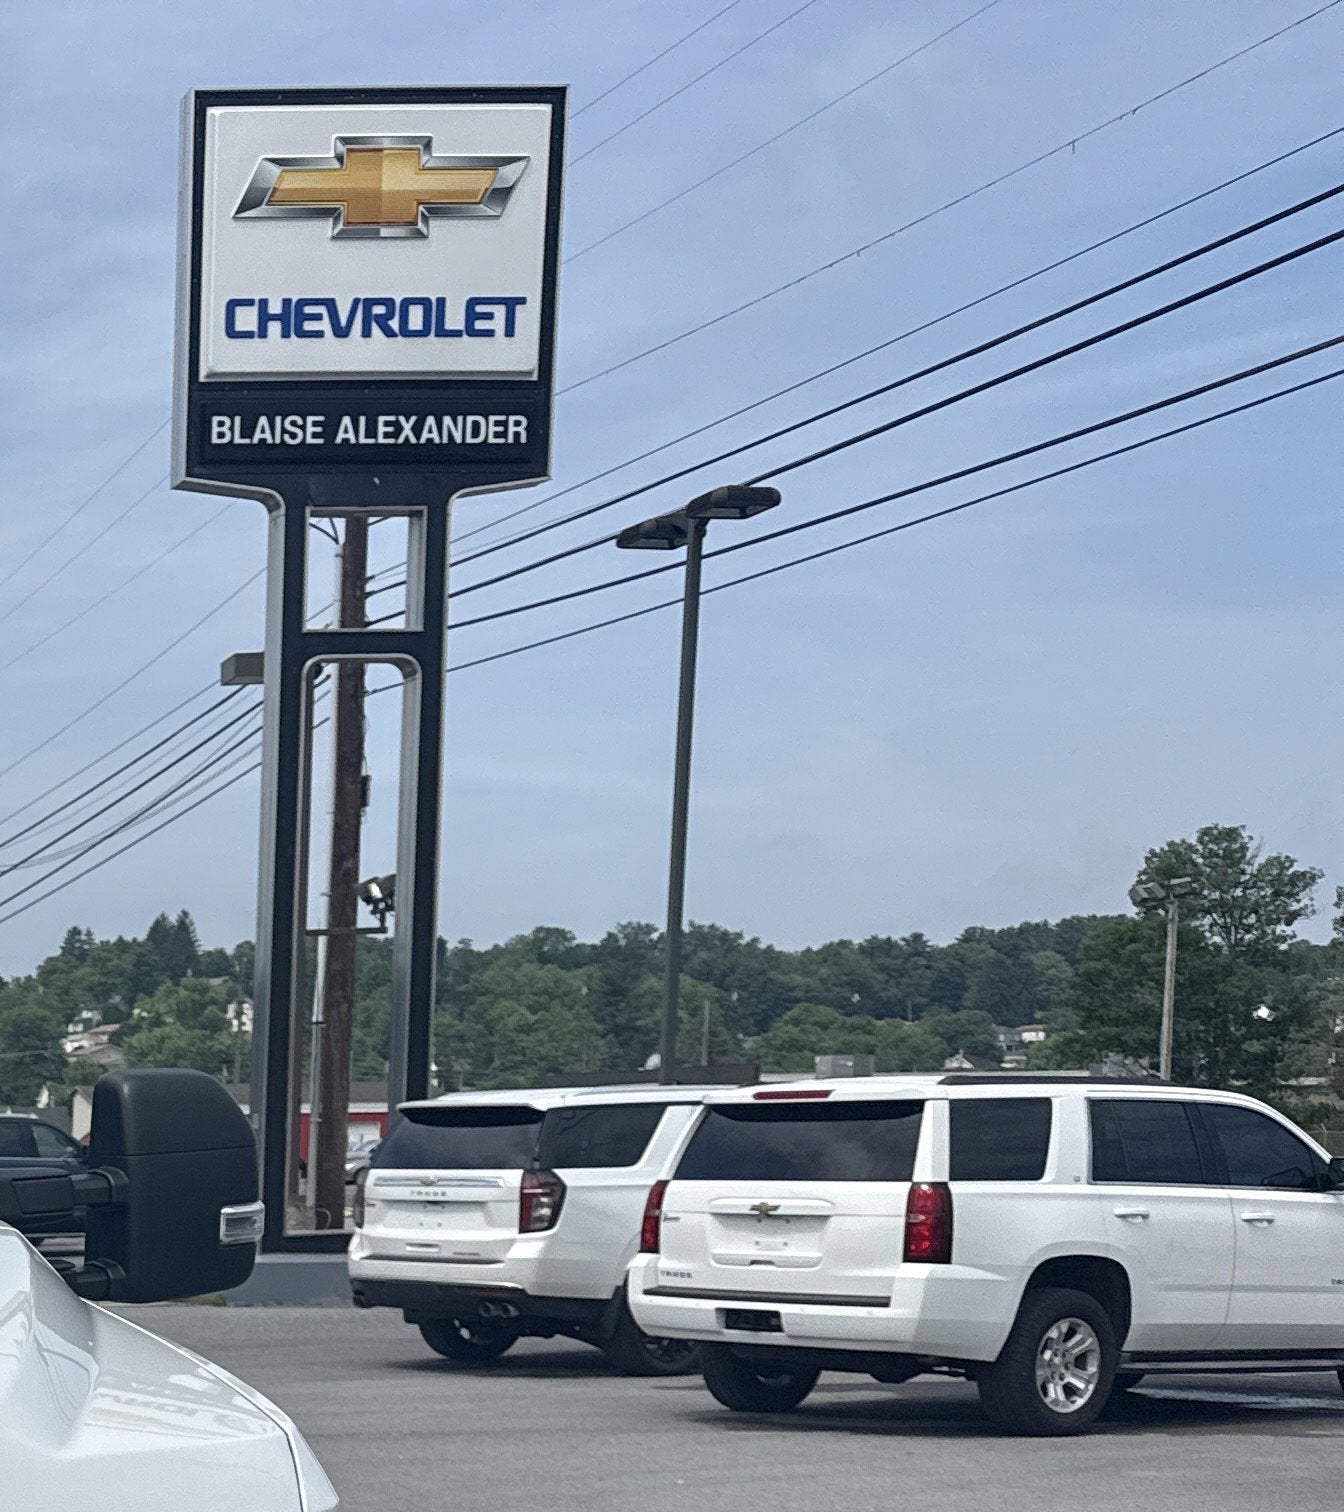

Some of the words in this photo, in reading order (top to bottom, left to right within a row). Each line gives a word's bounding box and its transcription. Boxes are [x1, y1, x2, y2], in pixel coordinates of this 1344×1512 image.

[224, 296, 527, 339] CHEVROLET
[211, 415, 325, 445] BLAISE
[334, 415, 528, 445] ALEXANDER
